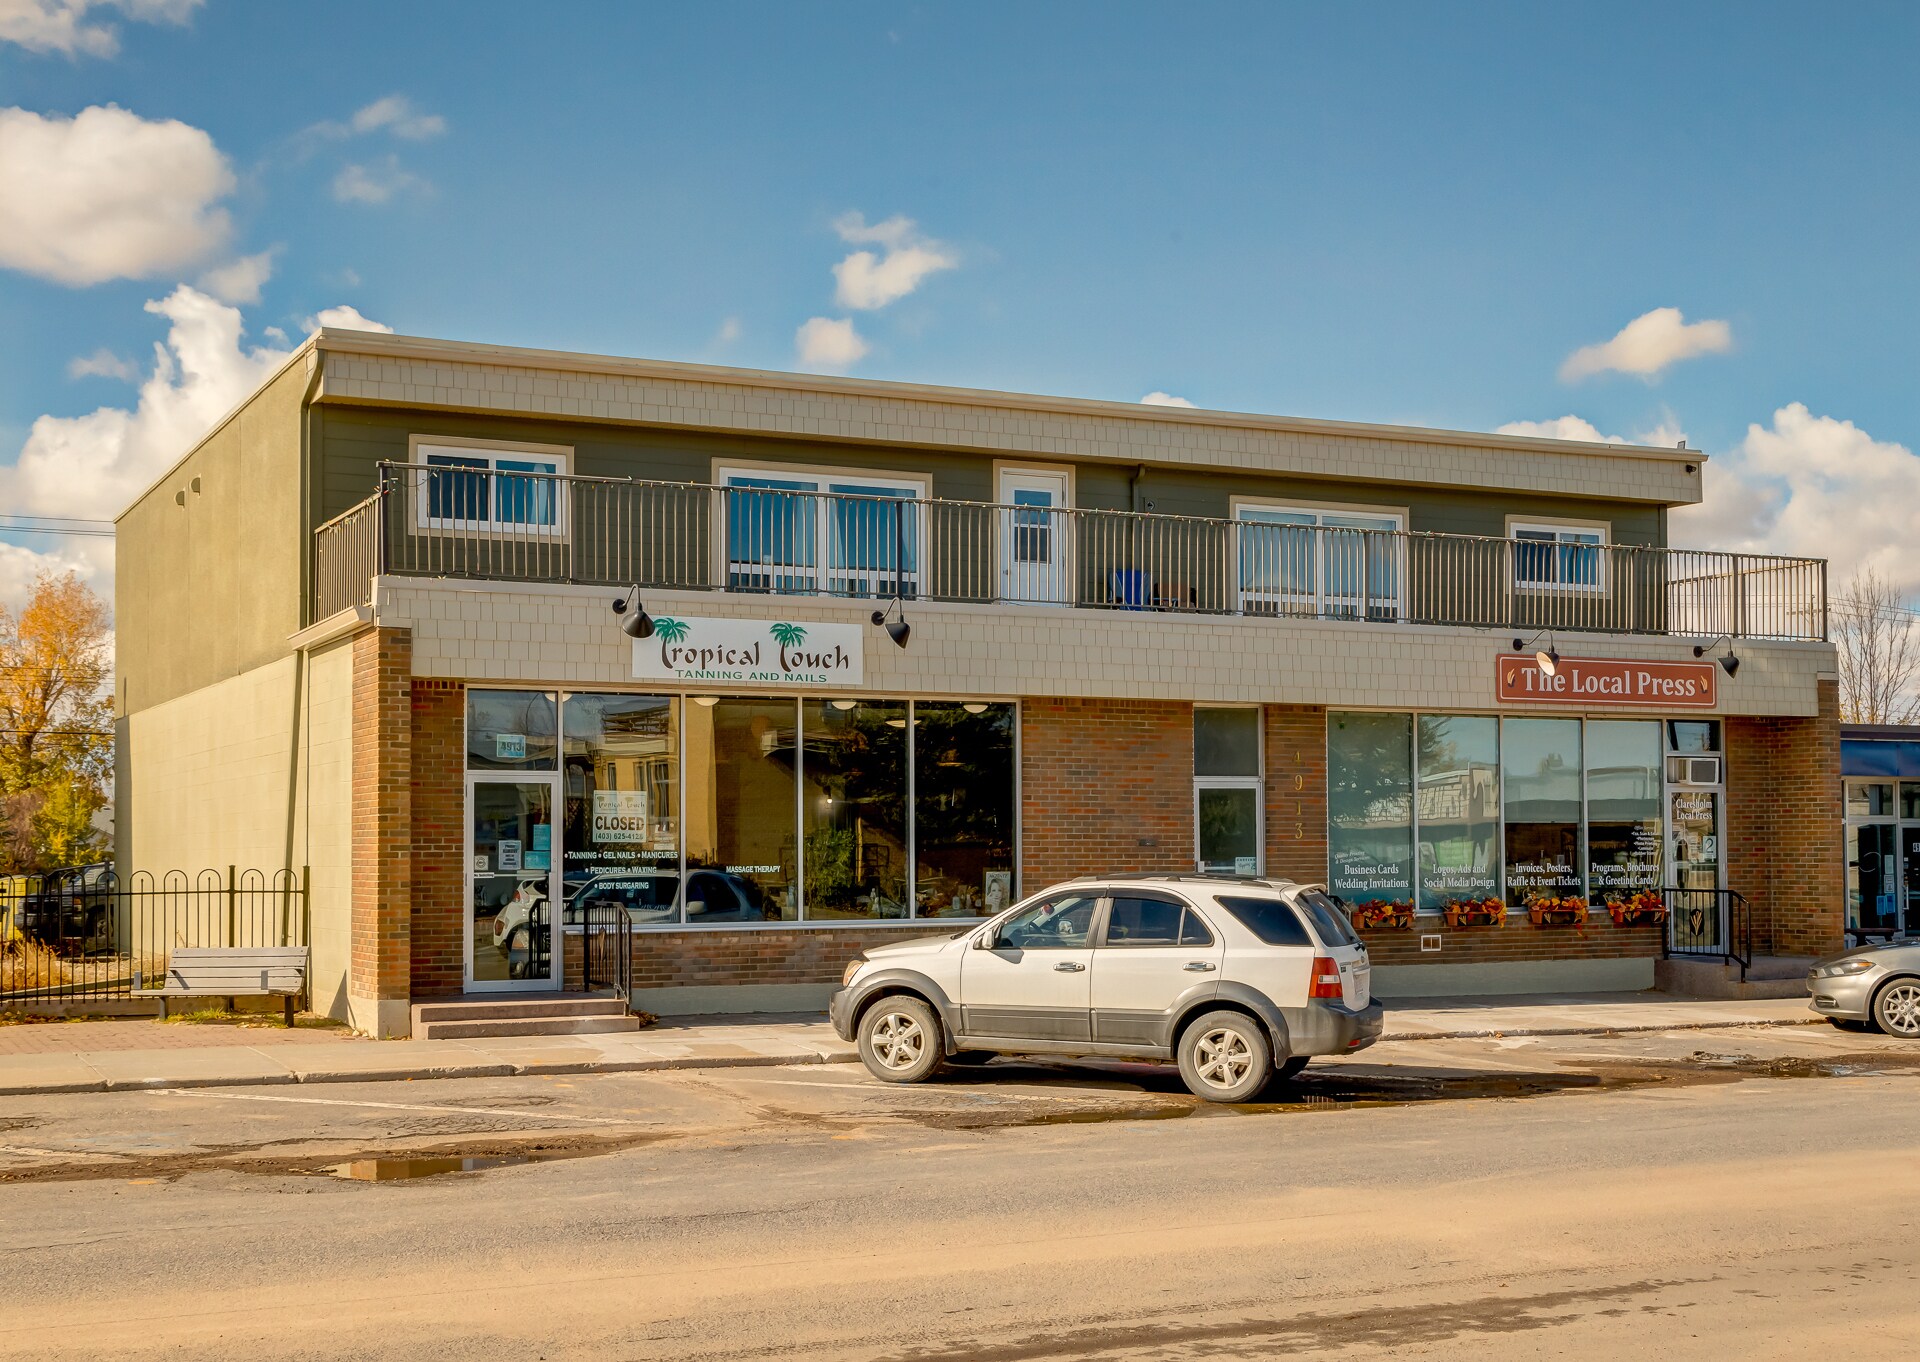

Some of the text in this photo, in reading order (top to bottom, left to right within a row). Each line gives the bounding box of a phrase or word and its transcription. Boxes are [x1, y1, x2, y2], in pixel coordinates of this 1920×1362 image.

[655, 618, 850, 672] Tropical Touch
[675, 669, 827, 683] TANNING AND NAILS
[1521, 667, 1696, 697] The Local Press
[1675, 798, 1713, 810] Claresholm
[1676, 810, 1713, 820] Local Press
[595, 815, 645, 831] CLOSED
[595, 833, 612, 841] (403)
[1705, 837, 1714, 853] 2
[568, 851, 678, 859] TANNING GEL NAILS MANICURES
[590, 866, 657, 874] PEDICURES WAXING
[725, 865, 781, 873] MASSAGE THERAPY
[1344, 863, 1399, 875] Business Cards
[1433, 863, 1486, 876] Logos, Ads and
[1515, 862, 1573, 874] Invoices, Posters,
[1591, 861, 1660, 874] Programs, Brochures
[598, 882, 649, 890] BODY SURGARING
[1334, 877, 1409, 891] Wedding Invitations
[1423, 877, 1495, 889] Social Media Design
[1507, 875, 1582, 887] Raffle & Event Tickets
[1598, 875, 1654, 887] & Greeting Cards
